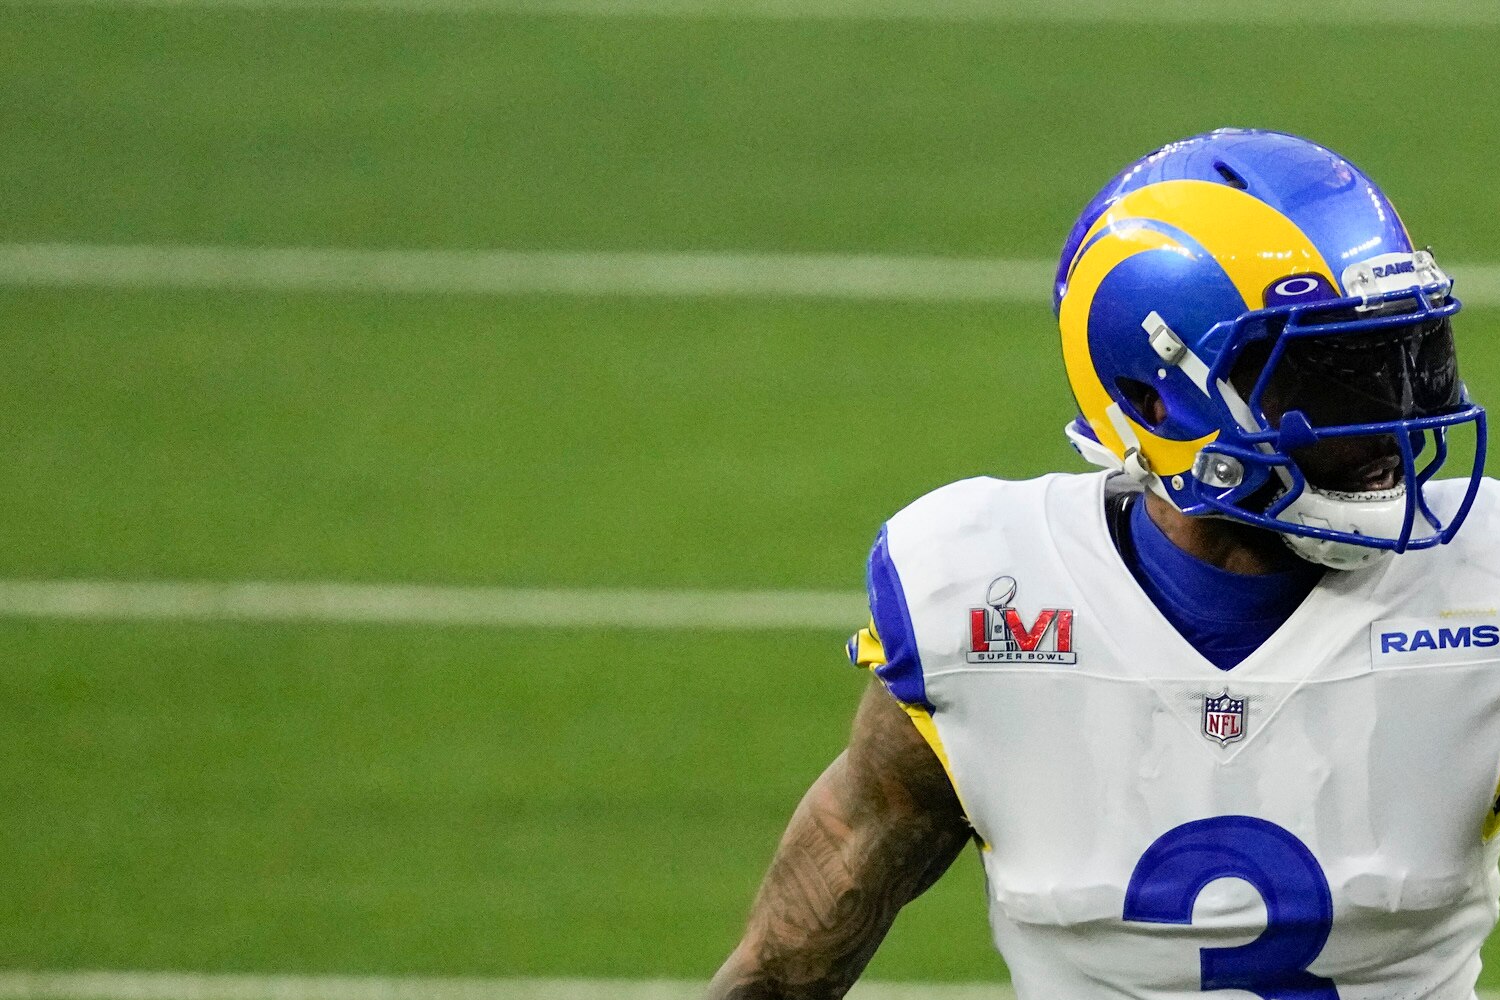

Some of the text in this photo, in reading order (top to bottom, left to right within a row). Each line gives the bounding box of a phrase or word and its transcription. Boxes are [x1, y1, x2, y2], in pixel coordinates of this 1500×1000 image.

[1381, 625, 1500, 654] RAMS
[978, 653, 1065, 661] SUPER BOWL
[1209, 714, 1240, 737] NFL
